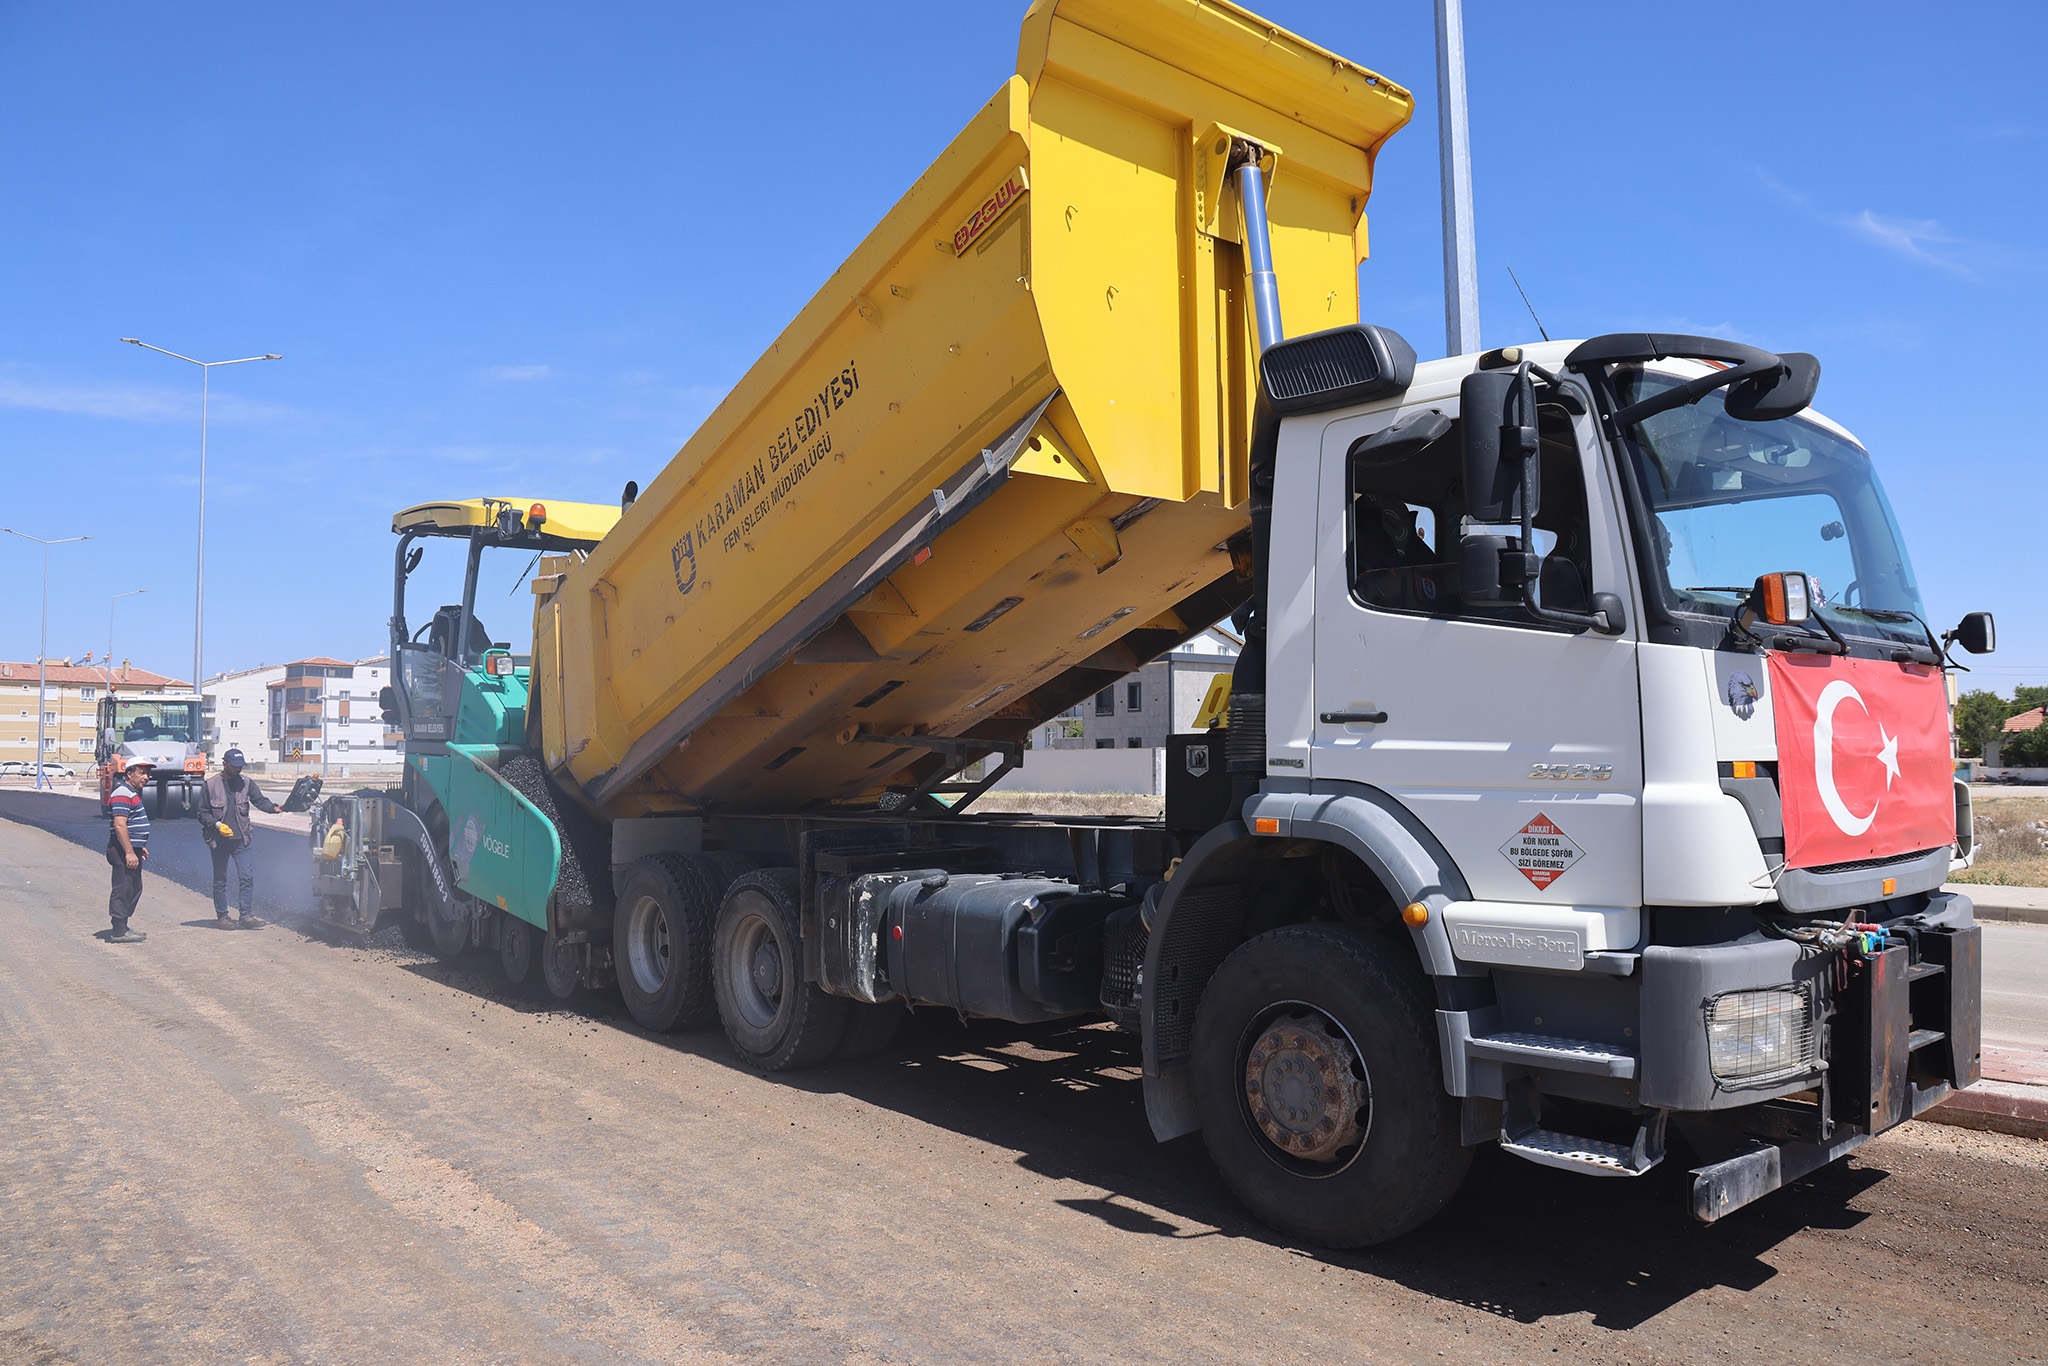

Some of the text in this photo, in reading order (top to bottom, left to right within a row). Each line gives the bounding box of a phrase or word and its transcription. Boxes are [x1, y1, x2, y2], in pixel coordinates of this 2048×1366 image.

[695, 360, 860, 549] KARAMAN BELEDİYESİ
[723, 529, 741, 553] FEN
[771, 431, 833, 508] MÜDÜRLÜĞÜ
[1528, 763, 1613, 781] 2529
[1528, 824, 1550, 833] DİKKAT
[420, 833, 434, 867] SUPER
[482, 834, 510, 859] VÖGELE
[1523, 836, 1559, 846] KÖR NOKTA
[1520, 847, 1549, 857] BÖLGEDE
[1518, 858, 1564, 869] SİZİ GÖREMEZ
[1461, 929, 1576, 954] Mercedes-Benz
